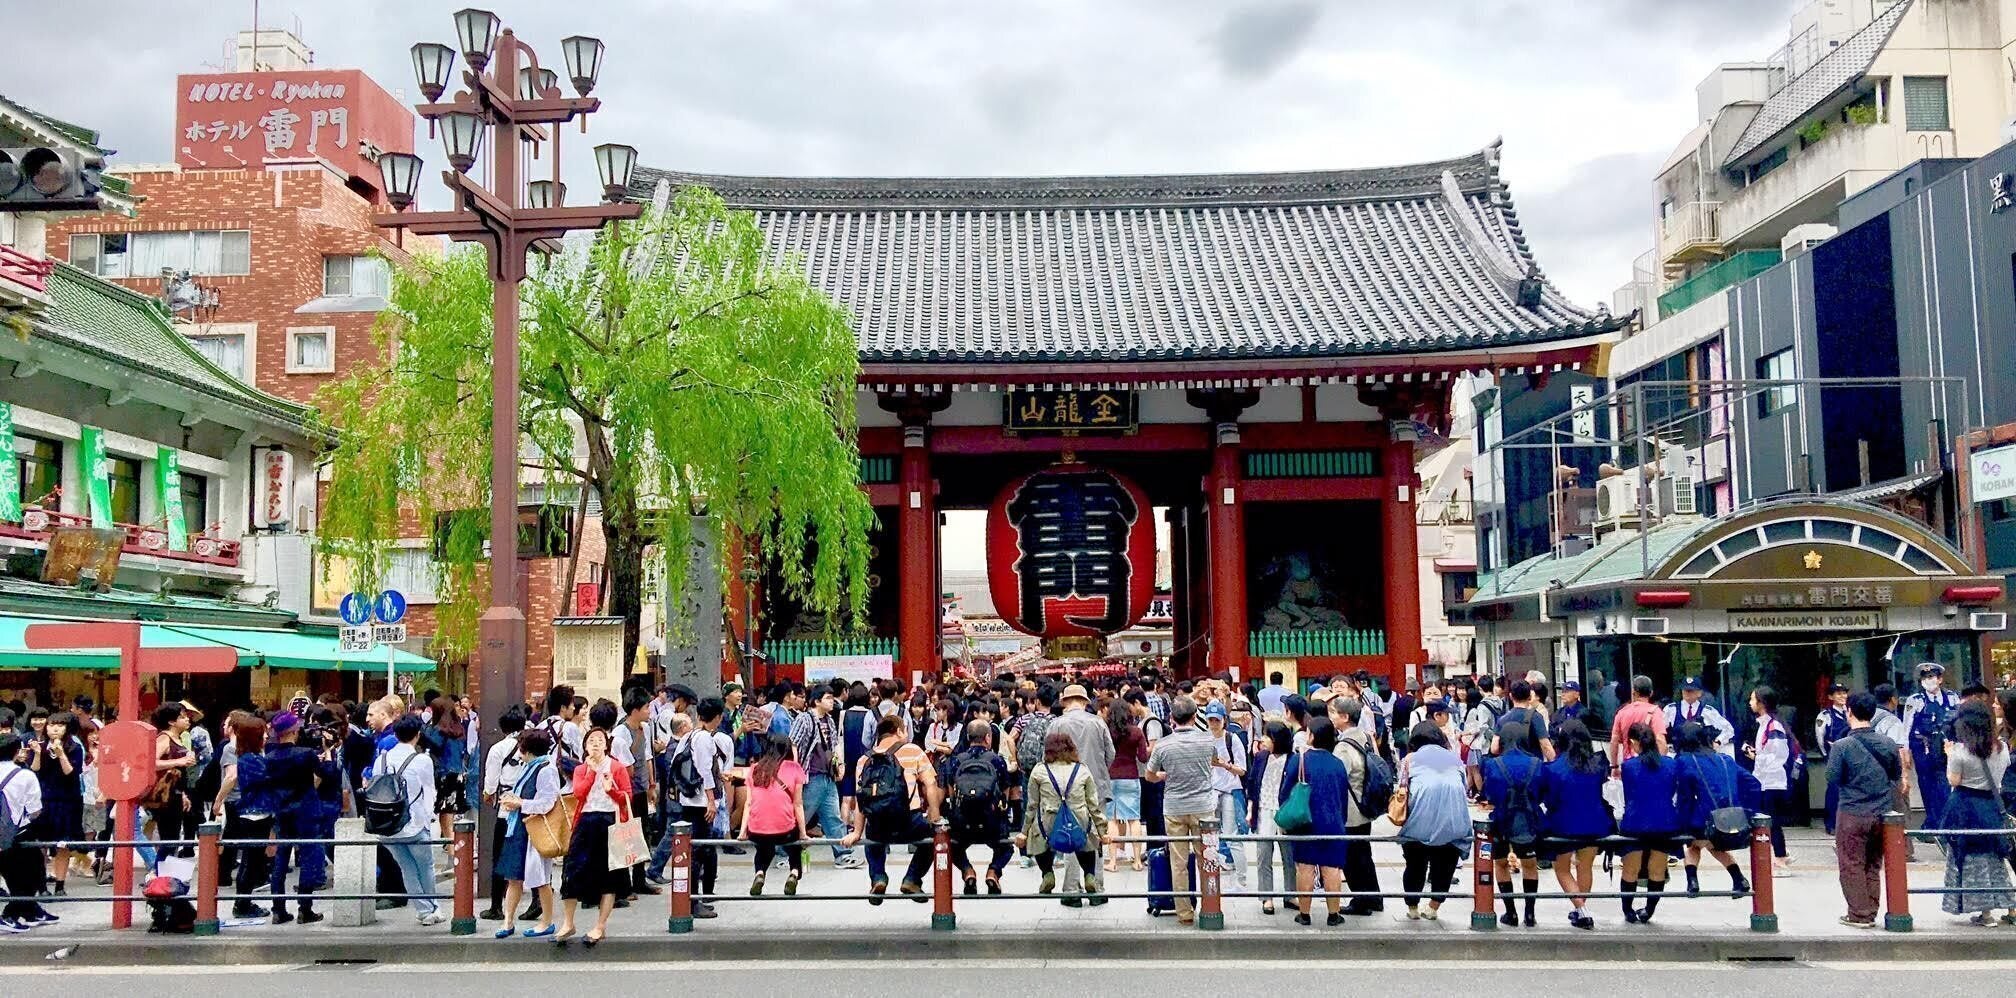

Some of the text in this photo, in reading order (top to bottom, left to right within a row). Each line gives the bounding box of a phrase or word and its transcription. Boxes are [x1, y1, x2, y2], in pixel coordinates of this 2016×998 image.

[271, 80, 346, 104] Ryokan
[1981, 478, 2015, 492] KOBAN
[1005, 470, 1139, 633] 雷門
[1808, 585, 1892, 606] 雷門交番
[1737, 615, 1870, 627] KAMINARIMON KOBAN
